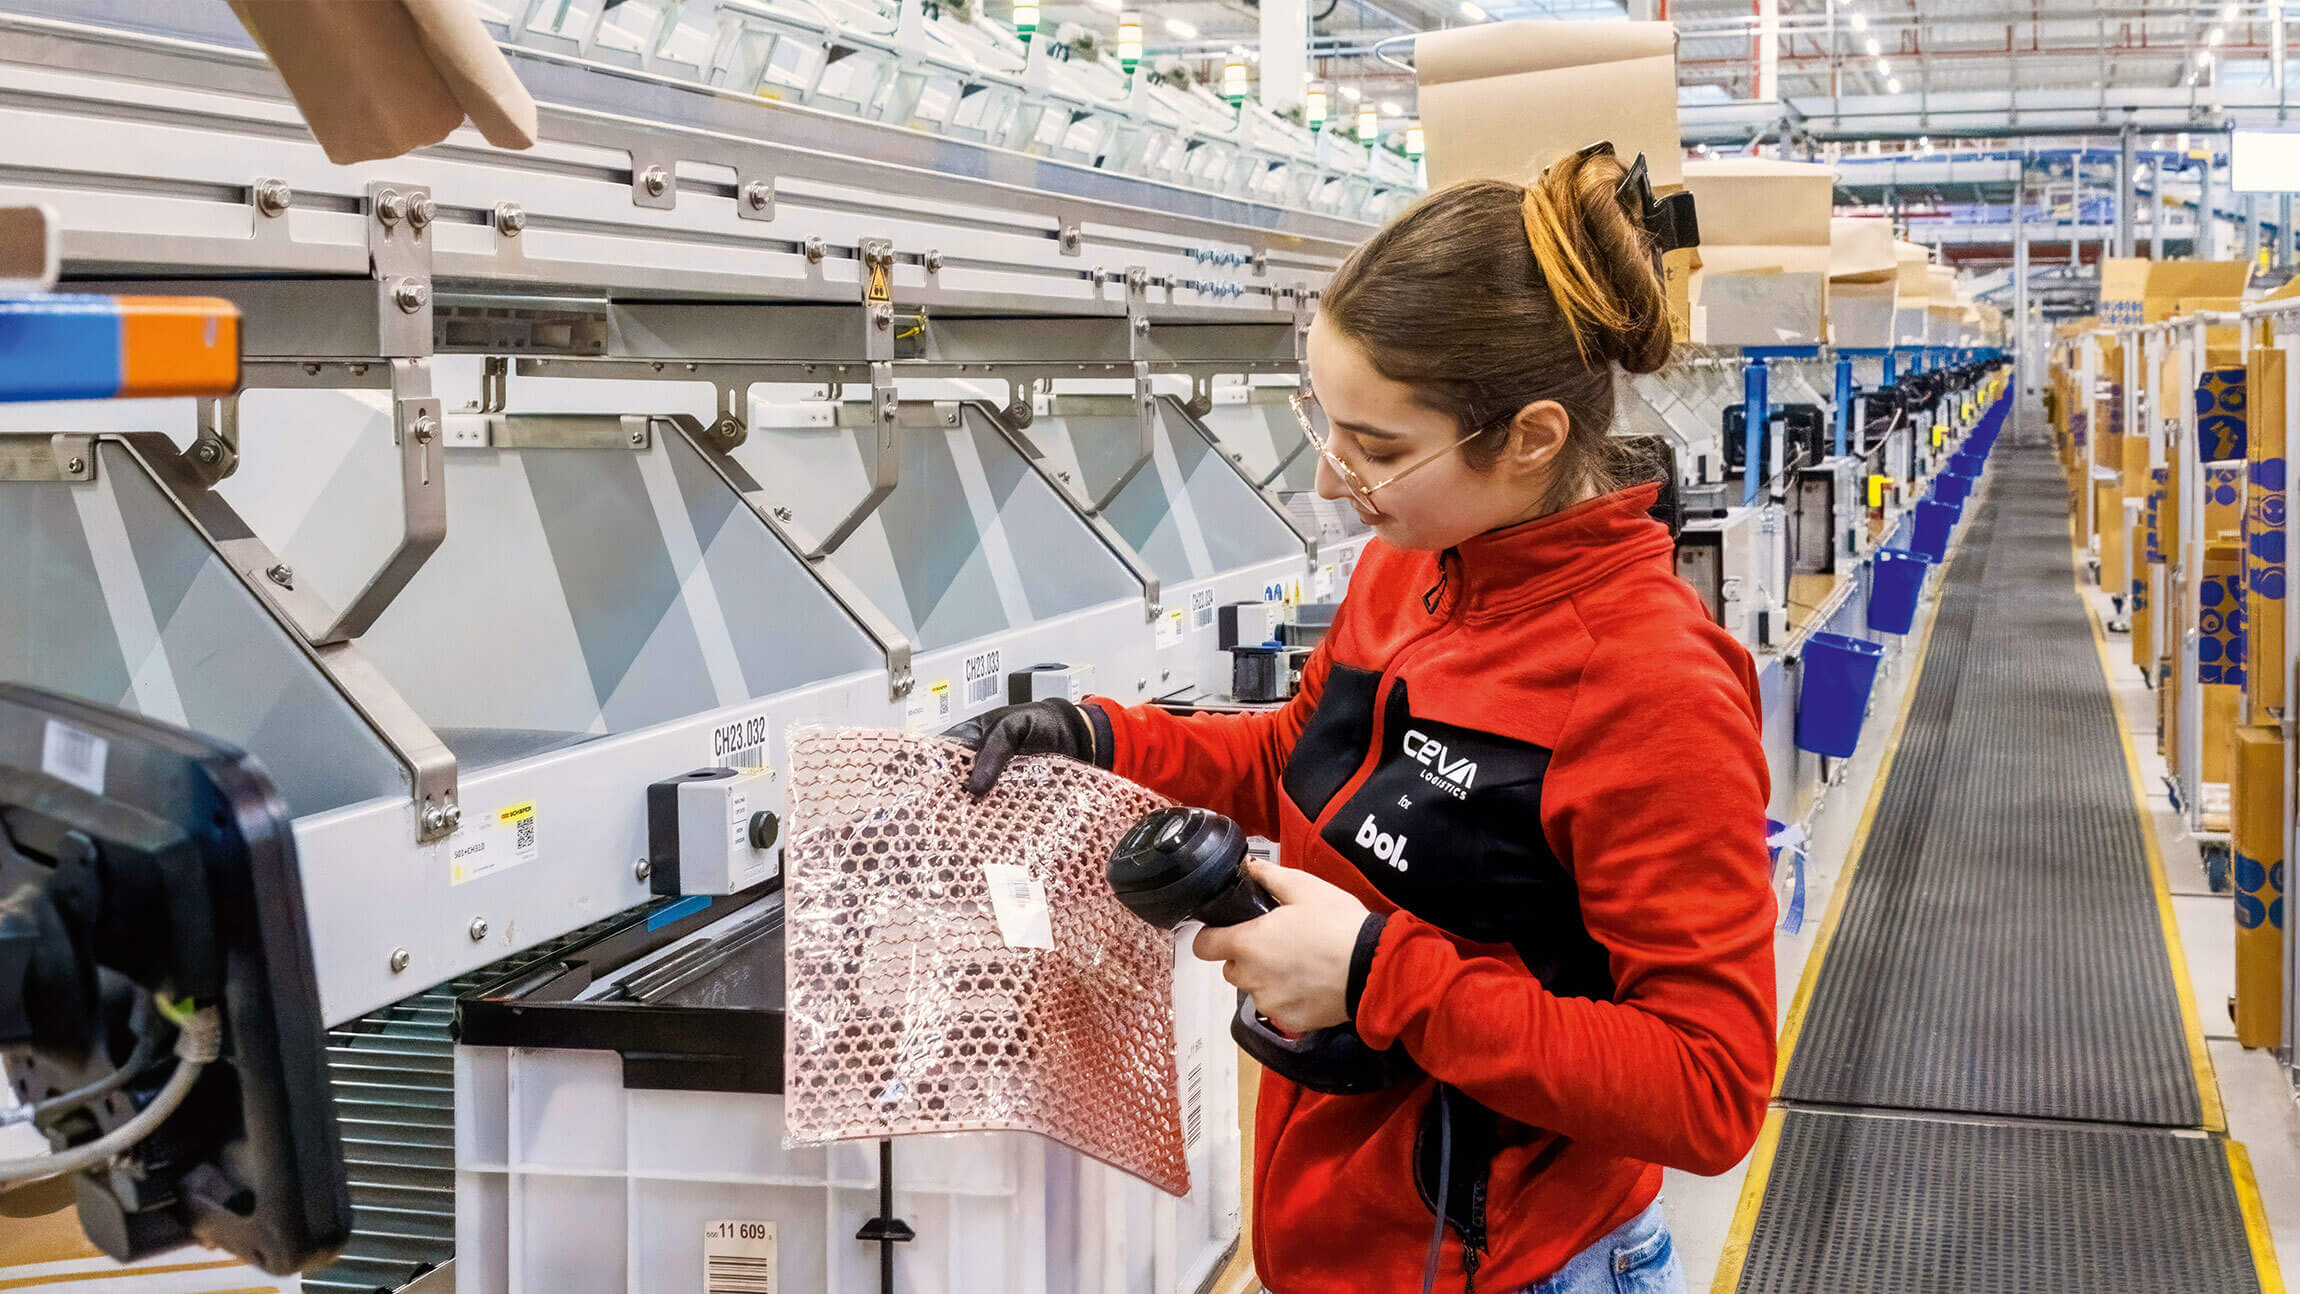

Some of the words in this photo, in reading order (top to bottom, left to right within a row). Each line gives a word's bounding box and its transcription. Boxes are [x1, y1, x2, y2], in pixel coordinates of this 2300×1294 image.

[965, 650, 1000, 682] CH23.033
[714, 716, 766, 757] CH23.032
[1419, 769, 1468, 801] LOGISTICS
[1397, 794, 1412, 809] for
[1355, 813, 1409, 872] bol.
[719, 1223, 734, 1238] 11
[740, 1223, 765, 1239] 609
